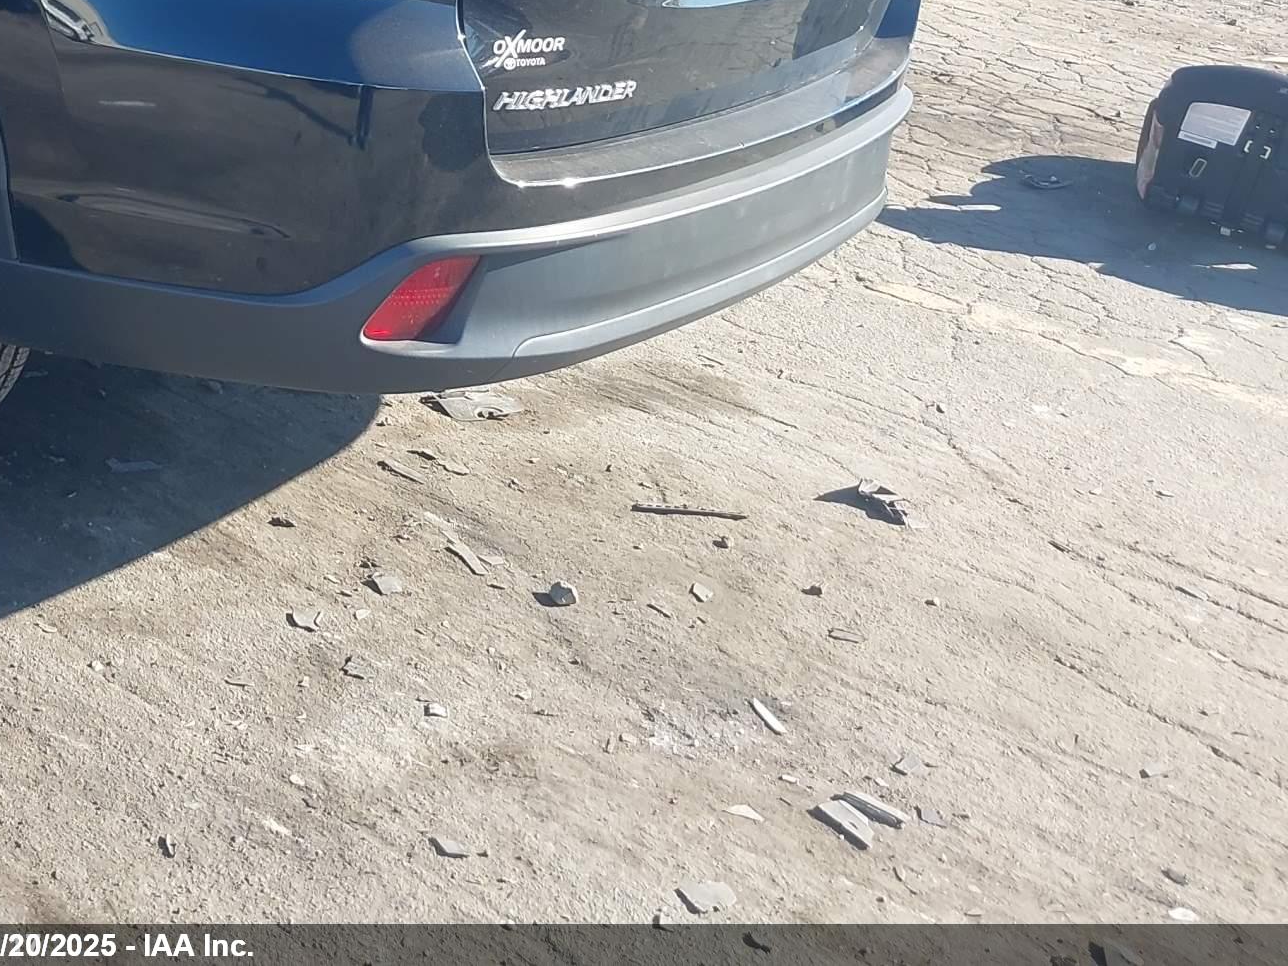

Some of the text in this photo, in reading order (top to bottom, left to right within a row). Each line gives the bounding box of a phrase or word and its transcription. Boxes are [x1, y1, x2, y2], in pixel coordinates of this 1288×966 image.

[492, 30, 566, 62] OXMOOR
[515, 56, 546, 68] TOYOTA
[492, 80, 638, 111] HIGHLANDER
